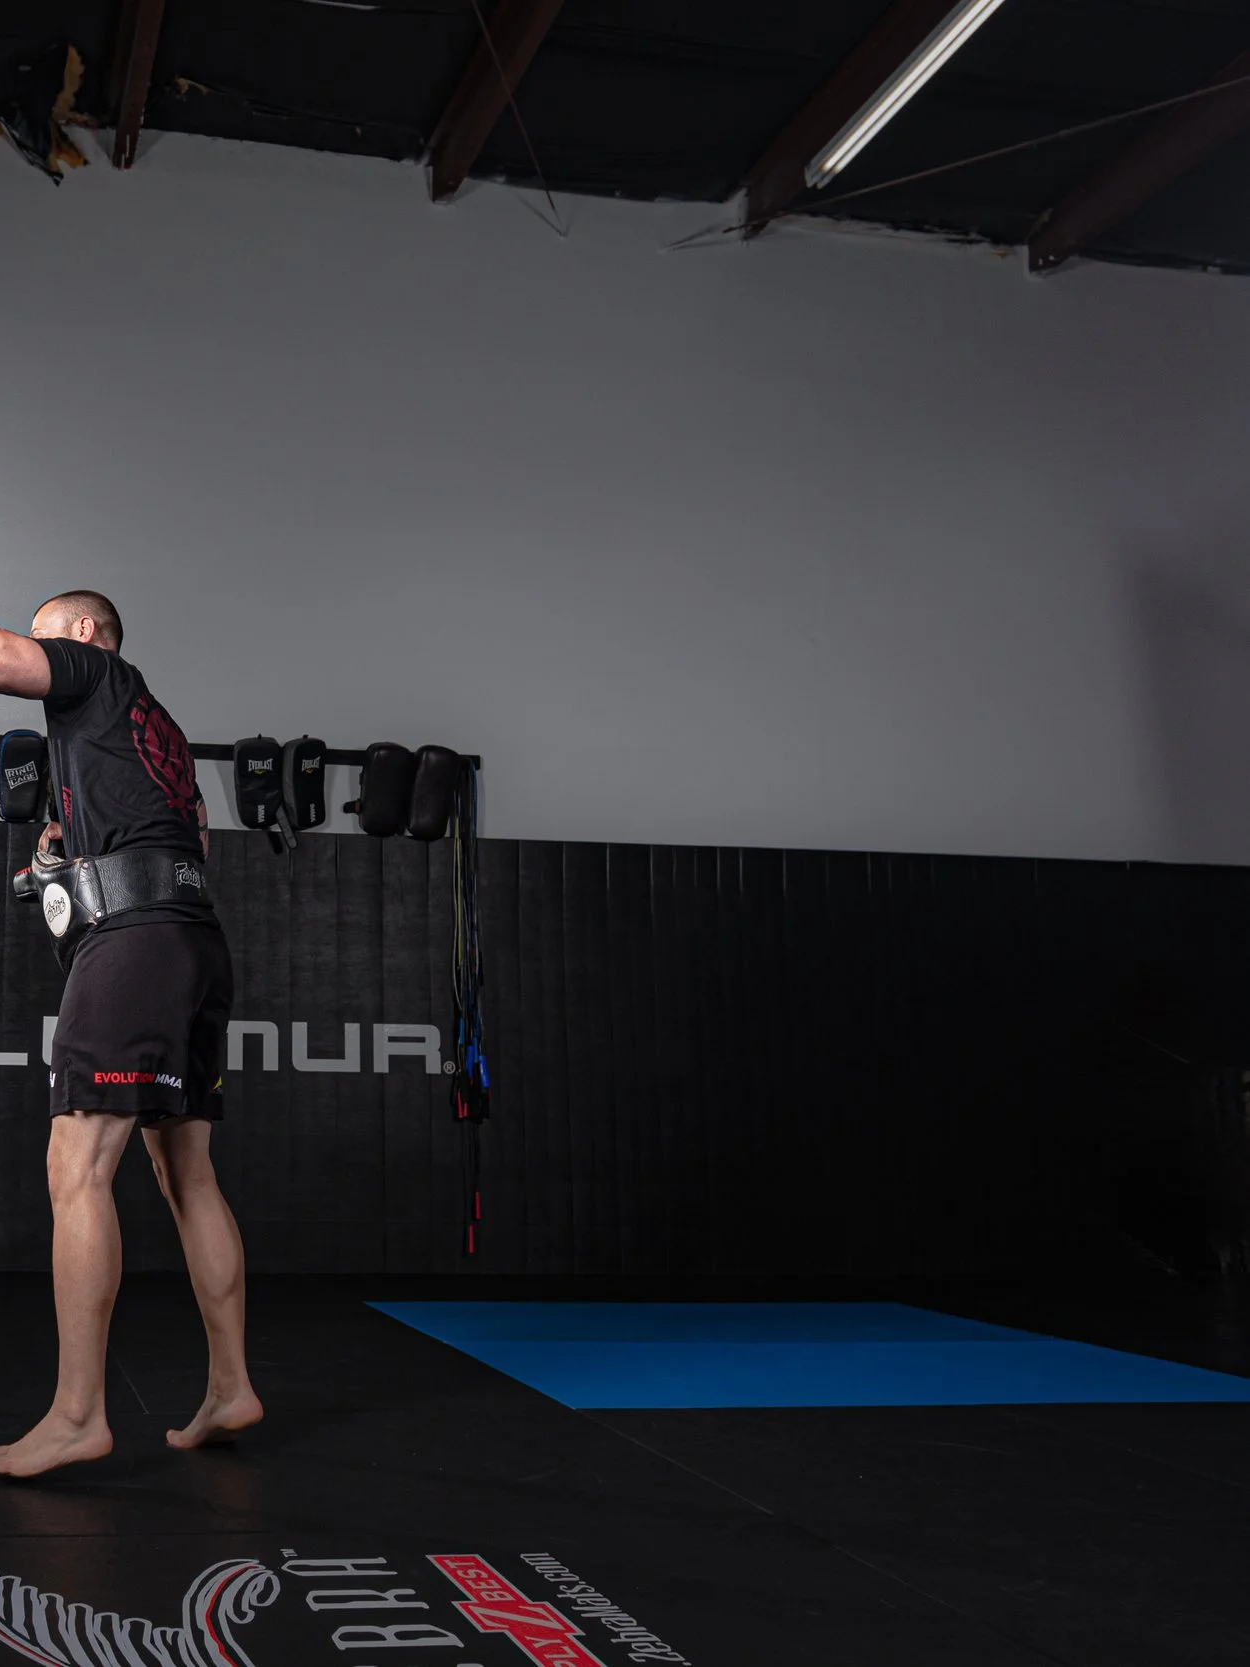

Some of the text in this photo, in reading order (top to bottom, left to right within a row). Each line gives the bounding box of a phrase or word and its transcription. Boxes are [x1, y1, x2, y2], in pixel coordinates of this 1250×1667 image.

[6, 762, 34, 778] RING
[248, 758, 273, 772] EVERLAST
[302, 756, 321, 772] EVERLAST
[10, 771, 36, 786] CAGE
[94, 1072, 182, 1089] EVOLUTION MMA
[443, 1558, 518, 1602] BEST
